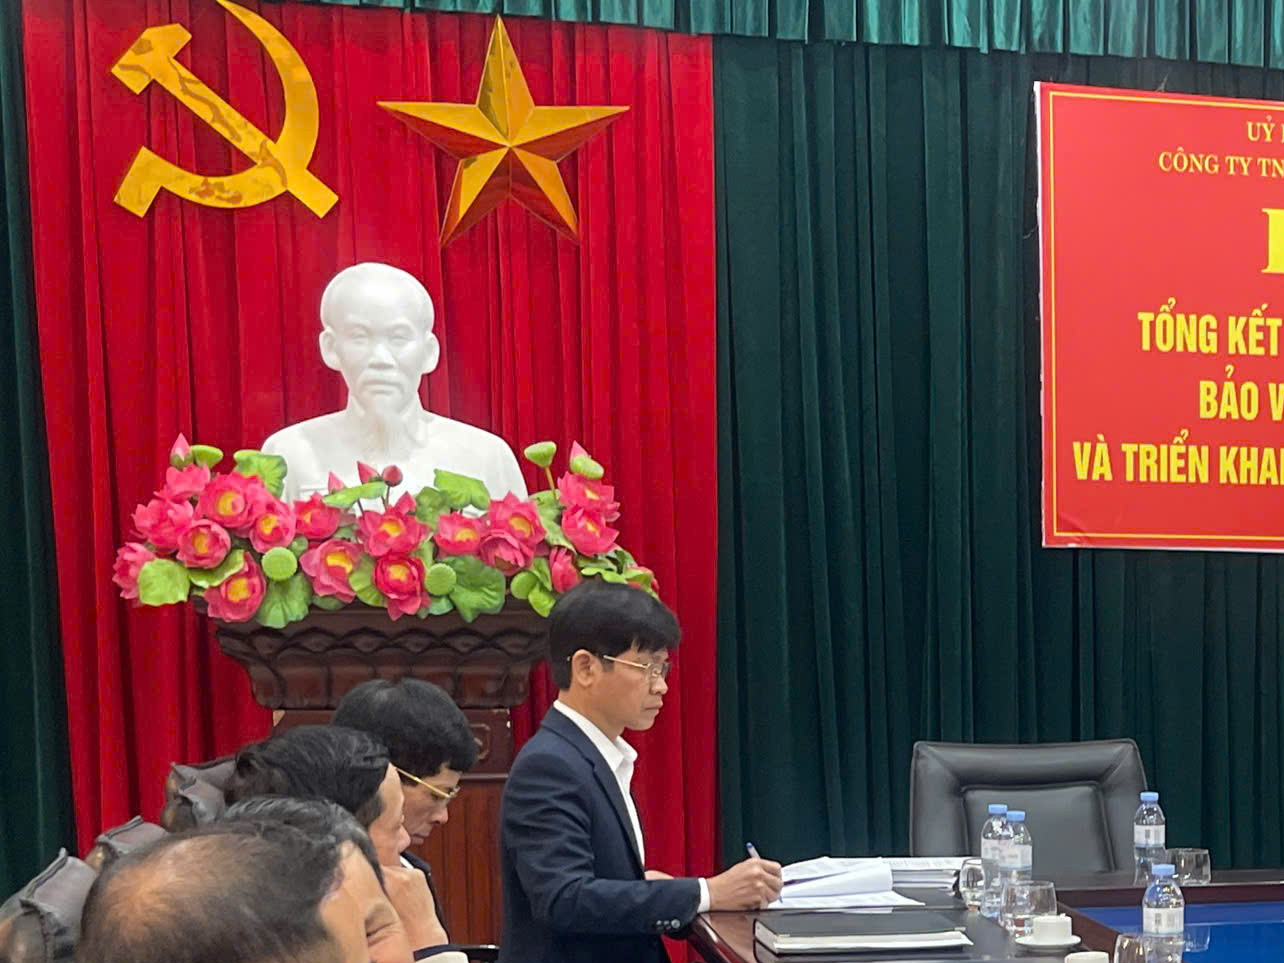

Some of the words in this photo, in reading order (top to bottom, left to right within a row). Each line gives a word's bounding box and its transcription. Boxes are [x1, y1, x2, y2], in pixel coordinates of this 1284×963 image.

[1246, 115, 1276, 143] UỶ
[1158, 146, 1220, 174] CÔNG
[1224, 155, 1253, 176] TY
[1137, 296, 1218, 354] TỔNG
[1227, 303, 1283, 356] KẾT
[1199, 365, 1259, 421] BẢO
[1072, 433, 1113, 481] VÀ
[1120, 430, 1209, 484] TRIỂN
